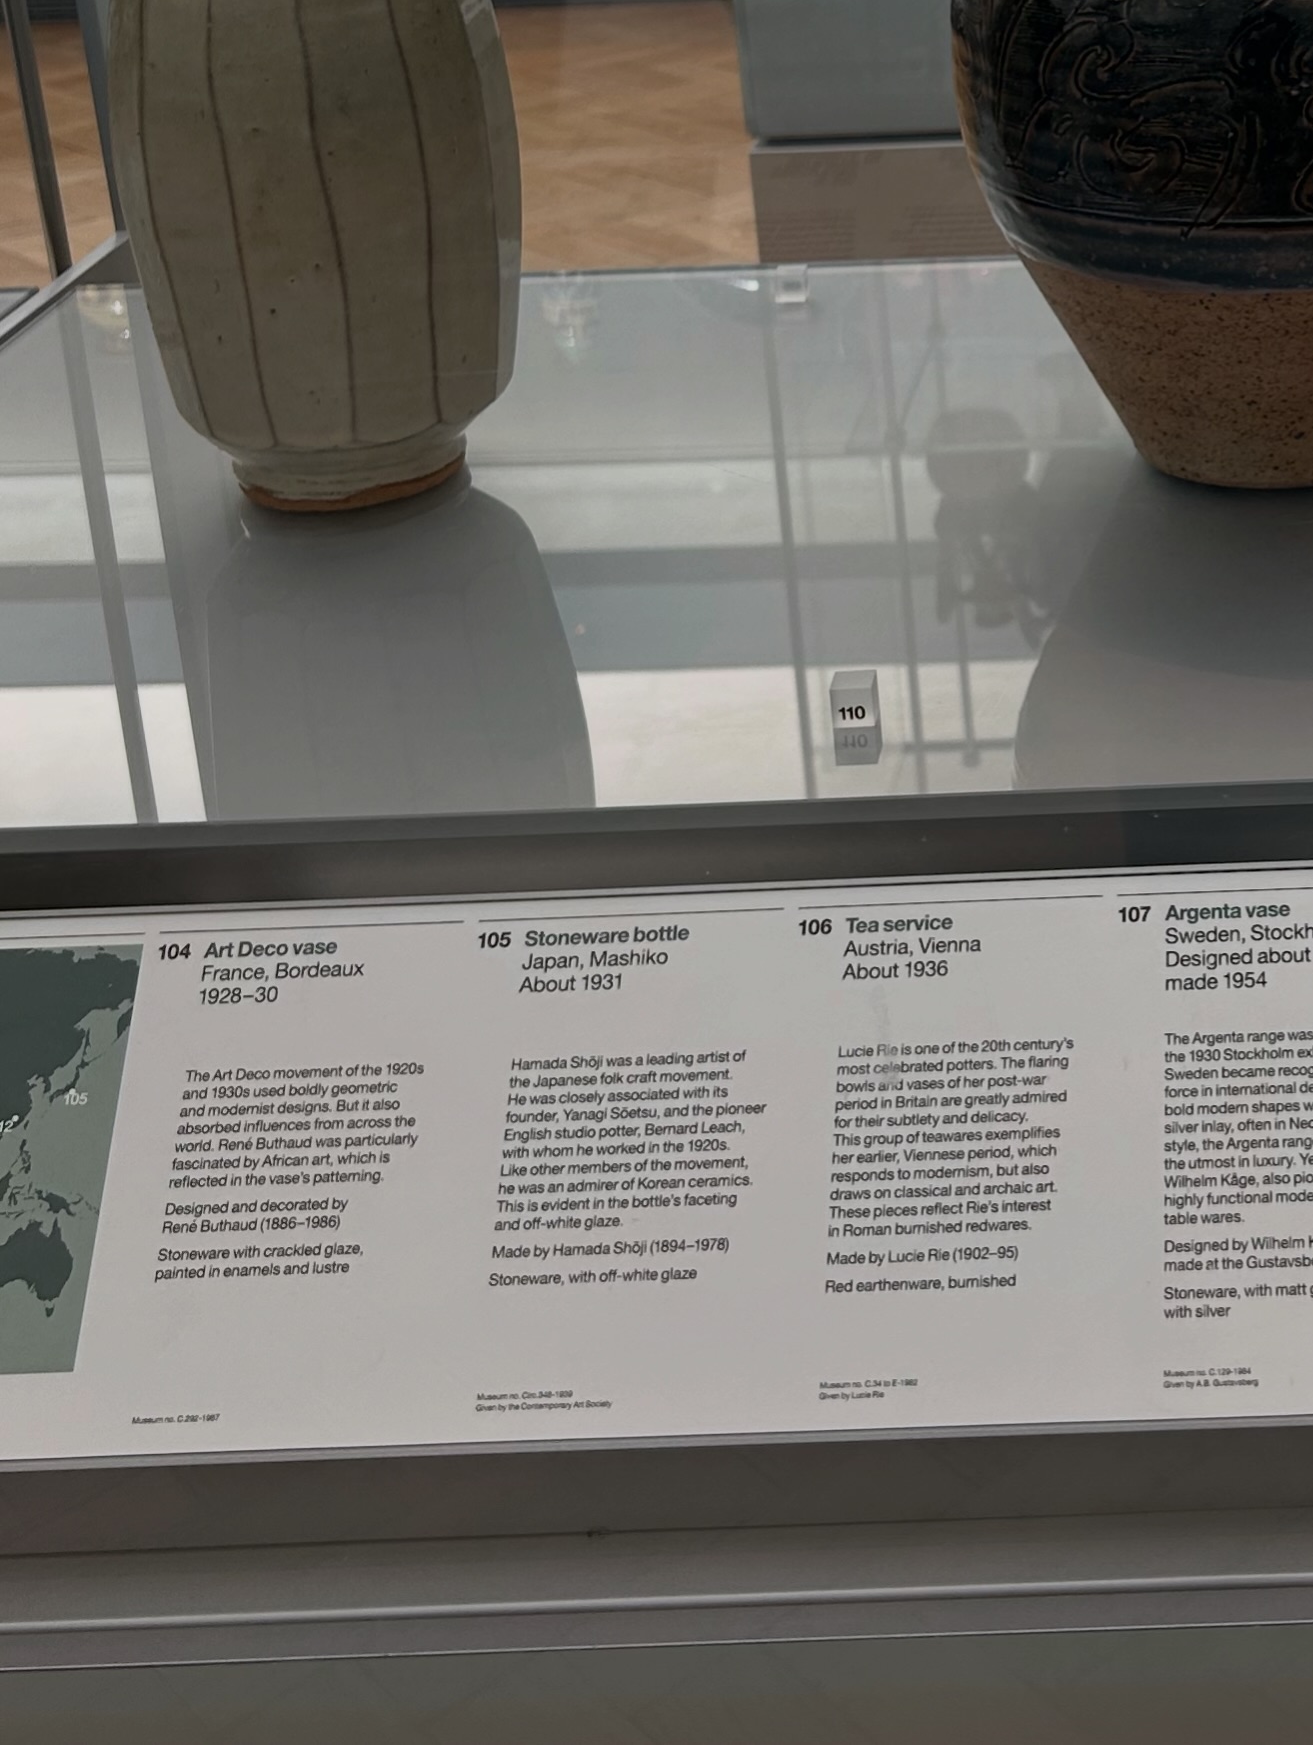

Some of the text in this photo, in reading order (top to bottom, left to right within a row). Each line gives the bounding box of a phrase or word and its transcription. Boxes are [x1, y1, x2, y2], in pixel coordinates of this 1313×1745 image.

[838, 705, 866, 721] 110
[1118, 903, 1291, 924] 107 Argenta vase
[798, 914, 953, 936] 106 Tea service
[1165, 926, 1246, 944] Sweden,
[478, 924, 690, 949] 105 Stoneware bottle
[158, 941, 338, 960] 104 Art Deco vase
[843, 937, 981, 957] Austria, Vienna
[522, 948, 668, 973] Japan, Mashiko
[1166, 948, 1253, 970] Designed
[1257, 947, 1311, 964] about
[201, 961, 364, 982] France, Bordeaux
[842, 960, 948, 980] About 1936
[518, 973, 622, 993] About 1931
[1165, 971, 1268, 991] made 1954
[200, 986, 278, 1005] 1928–30
[509, 1068, 732, 1090] the Japanese folk craft movement.
[64, 1092, 89, 1106] 105
[179, 1098, 400, 1118] and modernist designs. But it also
[1164, 1103, 1194, 1116] bold
[1197, 1101, 1249, 1115] modern
[1251, 1100, 1301, 1116] shapes
[830, 1181, 1057, 1201] draws on classical and archaic art.
[154, 1261, 350, 1283] painted in enamels and lustre
[1164, 1258, 1204, 1272] made
[1205, 1258, 1219, 1270] at
[1221, 1257, 1244, 1270] the
[488, 1273, 564, 1287] Stoneware,
[568, 1270, 596, 1284] with
[660, 1267, 698, 1284] glaze
[825, 1274, 1016, 1293] Red earthenware, burnished
